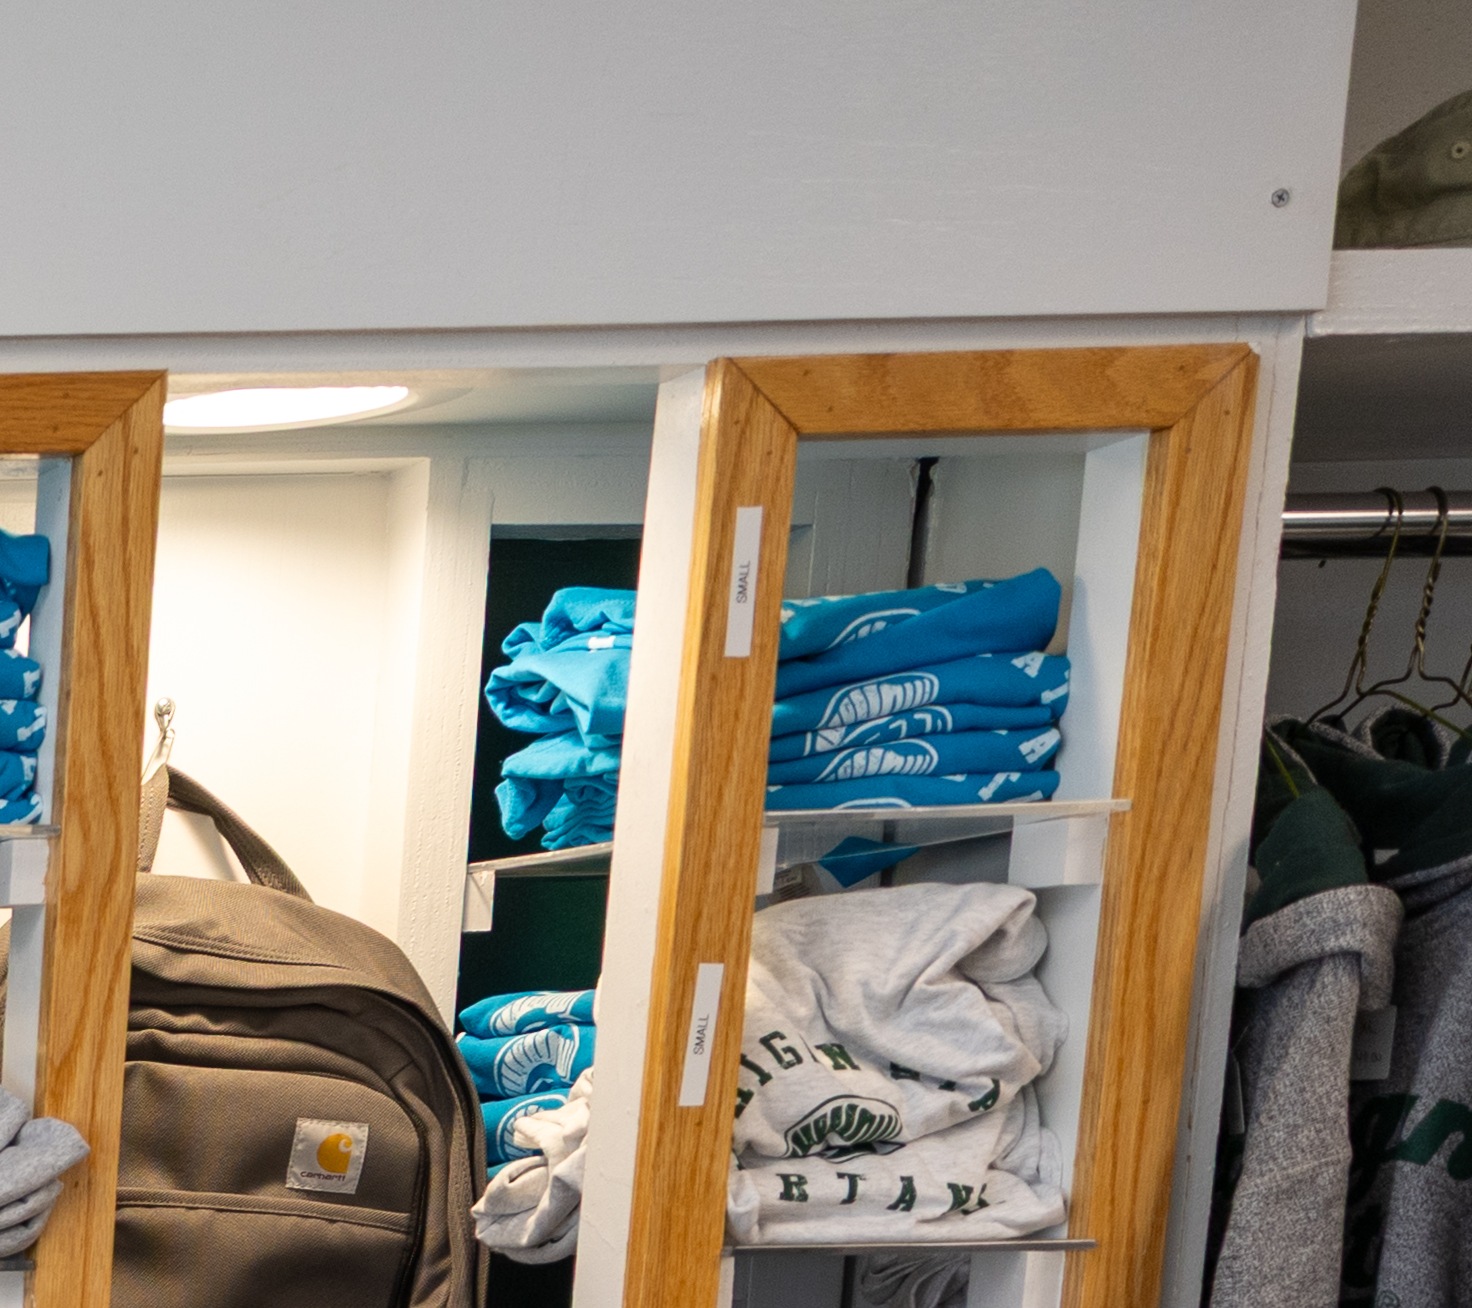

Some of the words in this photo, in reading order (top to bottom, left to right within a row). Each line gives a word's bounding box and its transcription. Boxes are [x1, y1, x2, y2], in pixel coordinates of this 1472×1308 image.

[735, 561, 751, 604] SMALL
[693, 1015, 710, 1055] SMALL
[300, 1171, 347, 1183] carhartt
